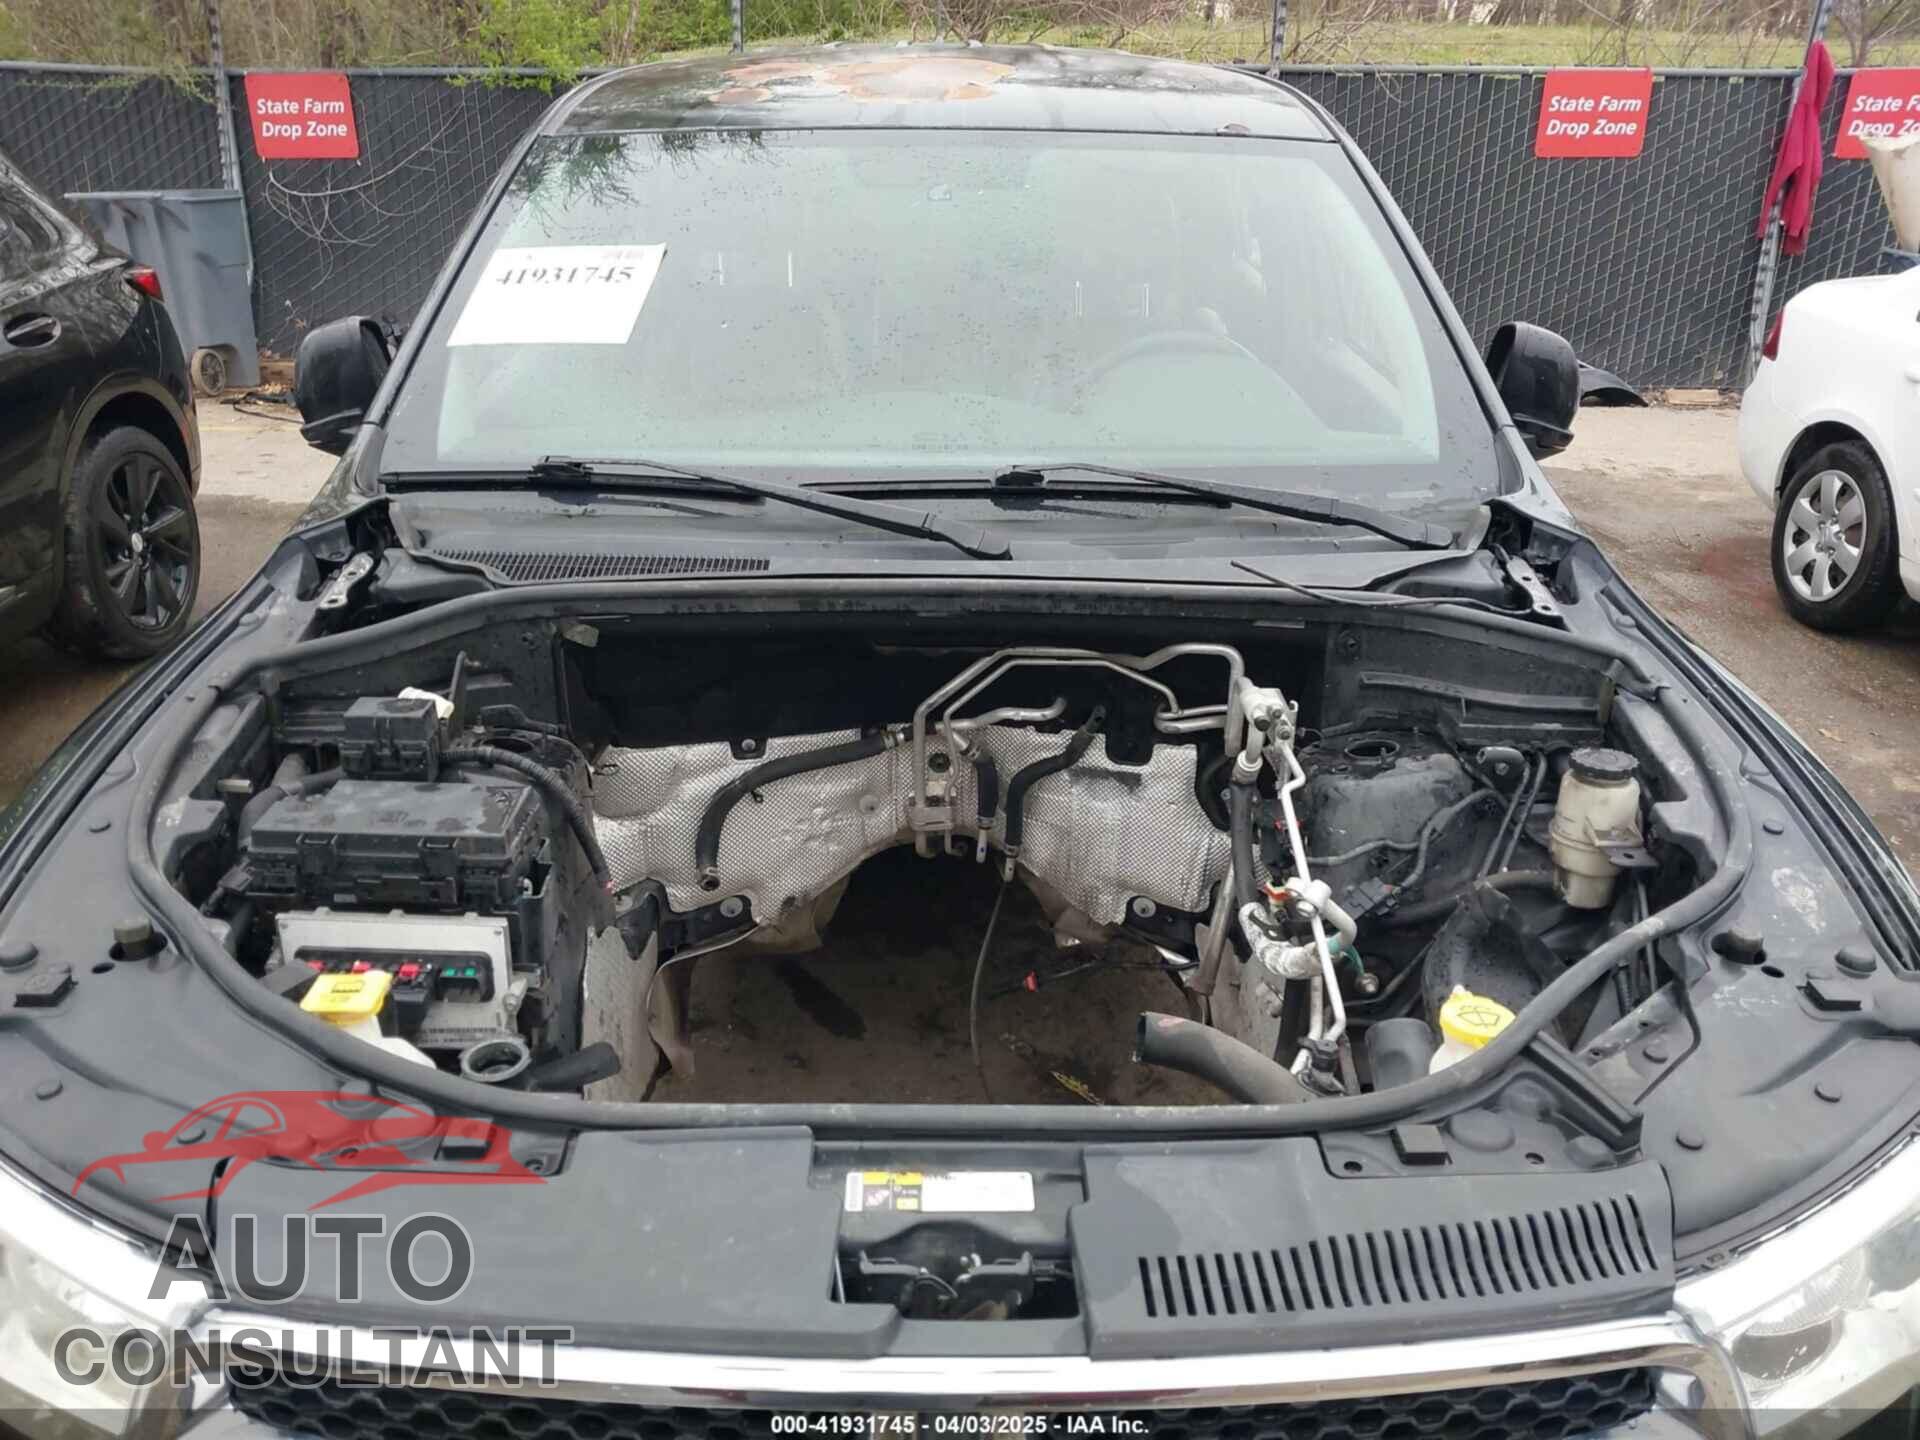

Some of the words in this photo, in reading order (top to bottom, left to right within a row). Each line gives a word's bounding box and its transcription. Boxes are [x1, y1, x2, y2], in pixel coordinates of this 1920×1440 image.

[257, 98, 299, 114] State
[304, 98, 345, 114] Farm
[1548, 95, 1595, 112] State
[1598, 95, 1642, 112] Farm
[1852, 95, 1903, 112] State
[262, 121, 302, 141] Drop
[306, 121, 348, 137] Zone
[1545, 119, 1590, 139] Drop
[1592, 119, 1638, 136] Zone
[496, 266, 635, 284] 41931745
